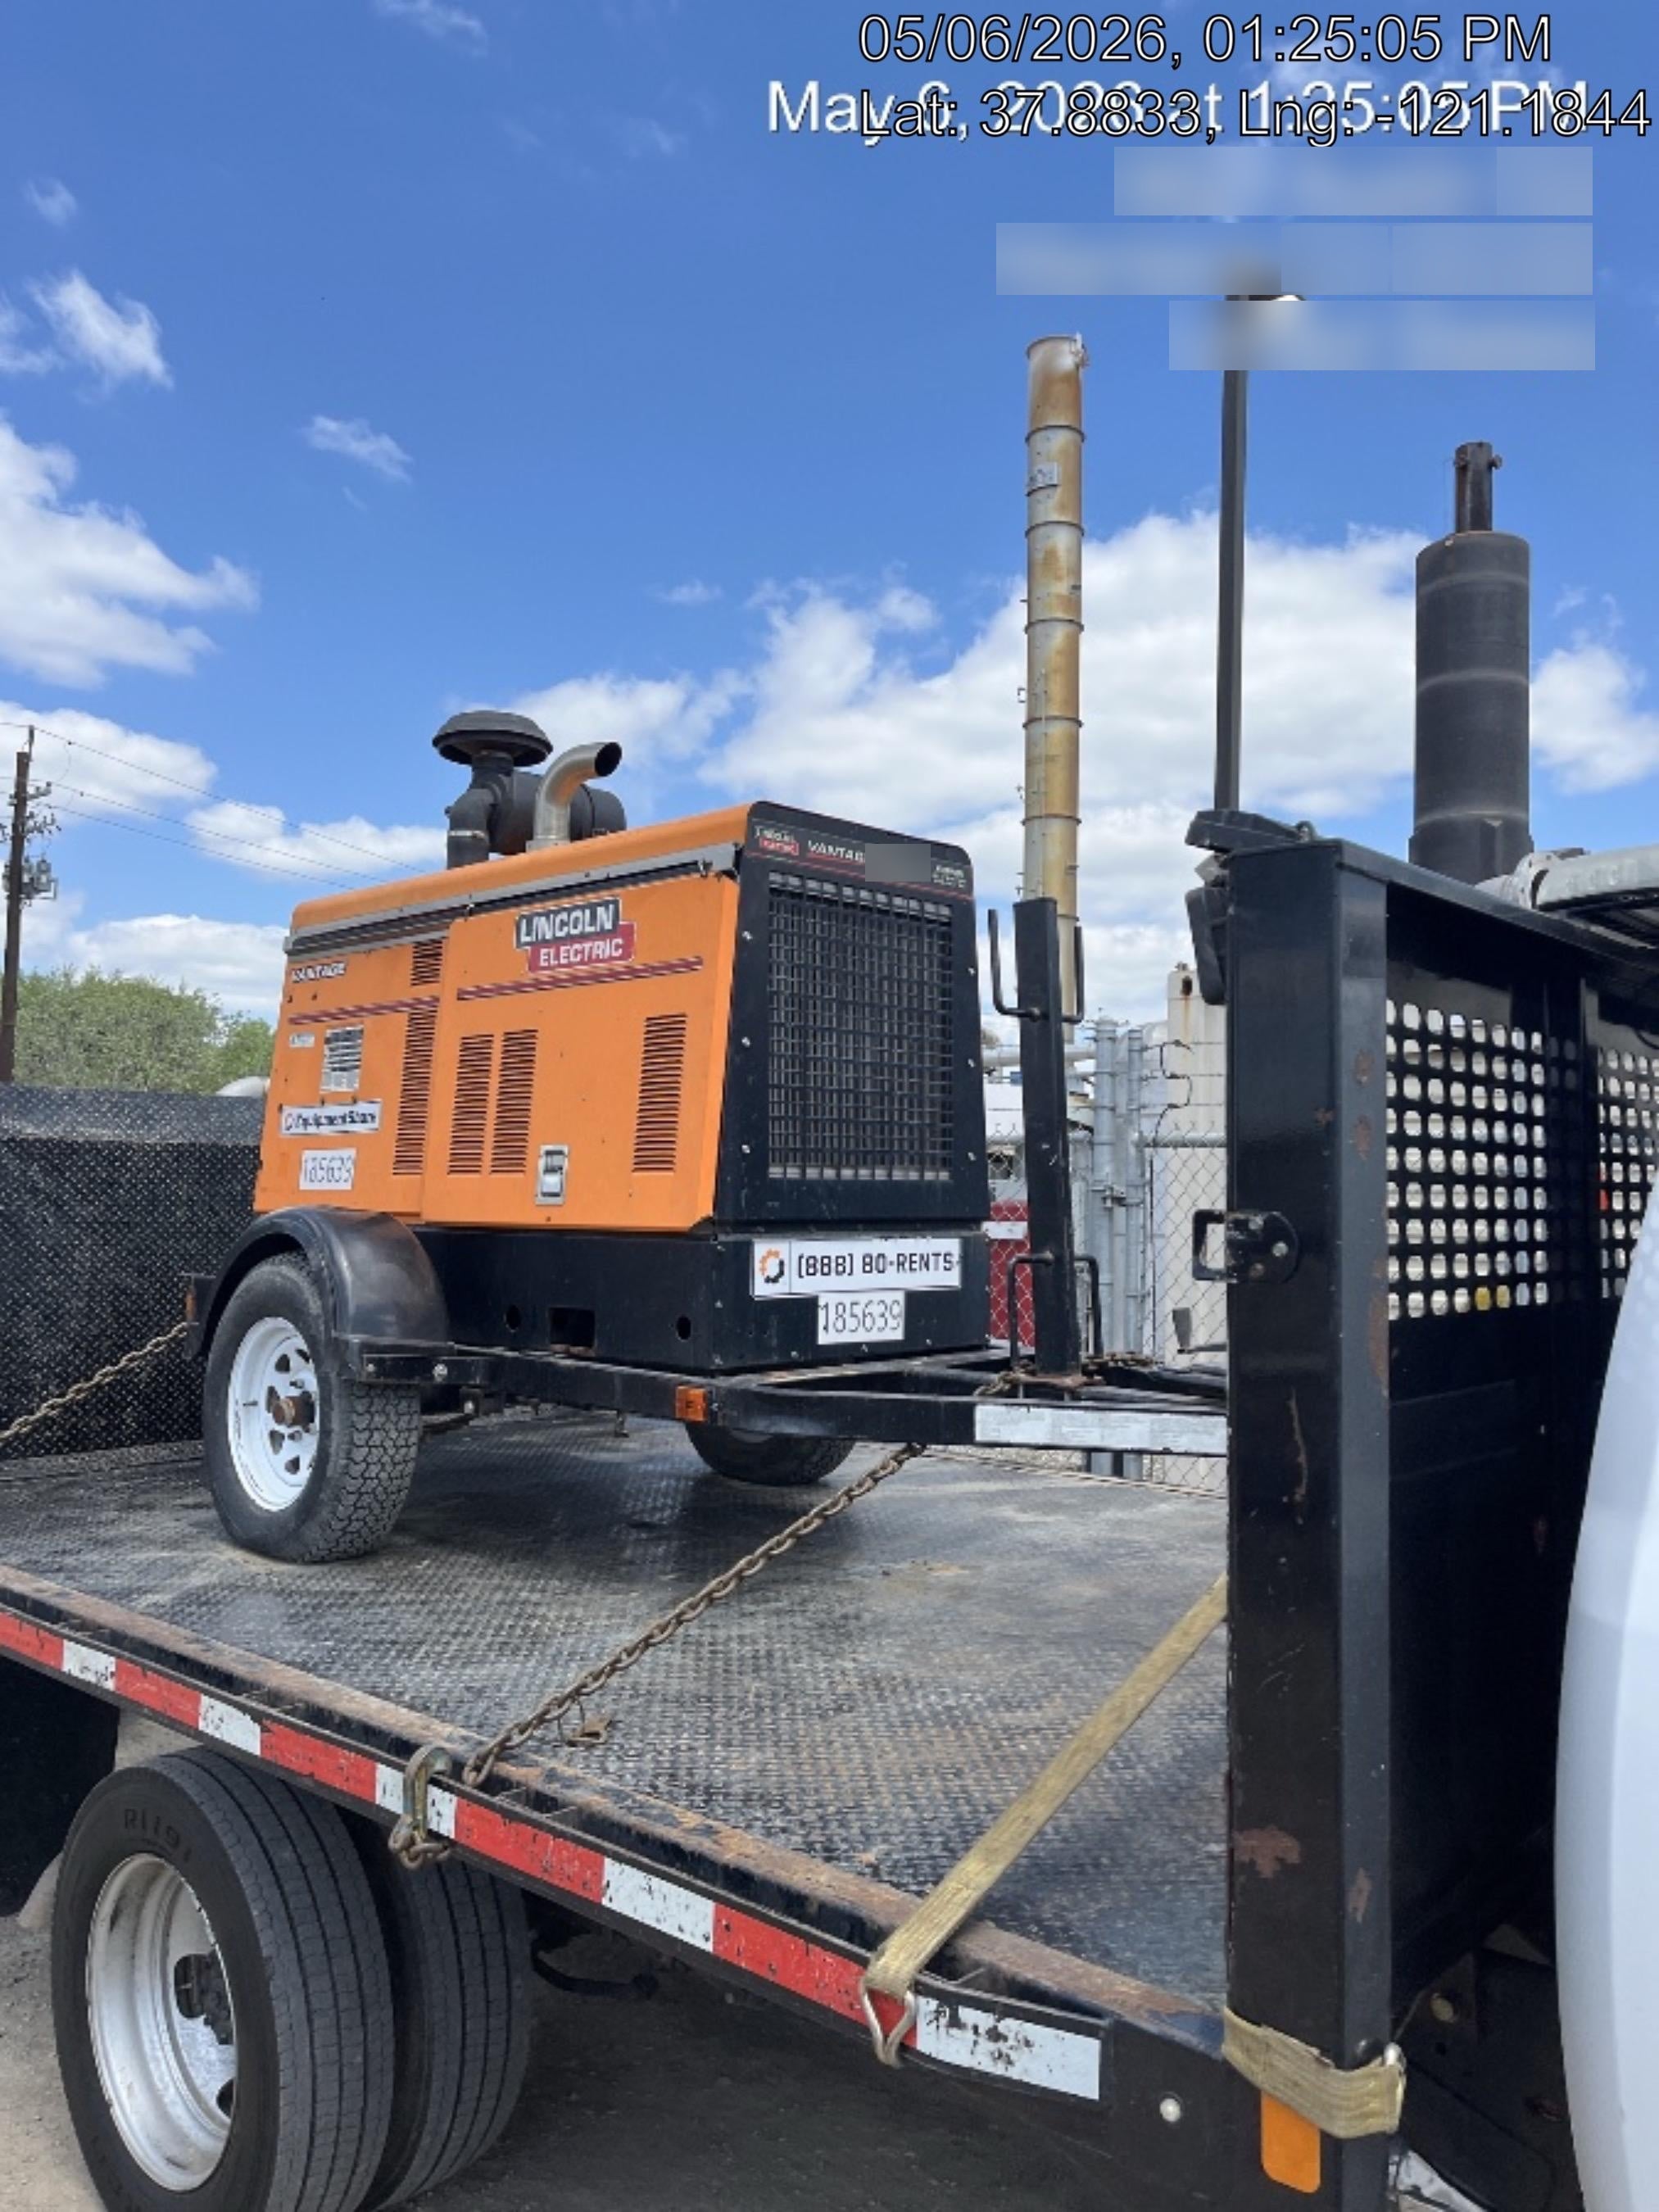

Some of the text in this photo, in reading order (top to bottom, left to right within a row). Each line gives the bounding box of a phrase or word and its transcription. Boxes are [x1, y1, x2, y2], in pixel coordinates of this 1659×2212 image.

[519, 904, 614, 944] LINCOLN
[539, 938, 623, 968] ELECTRIC
[819, 1299, 902, 1334] 185639
